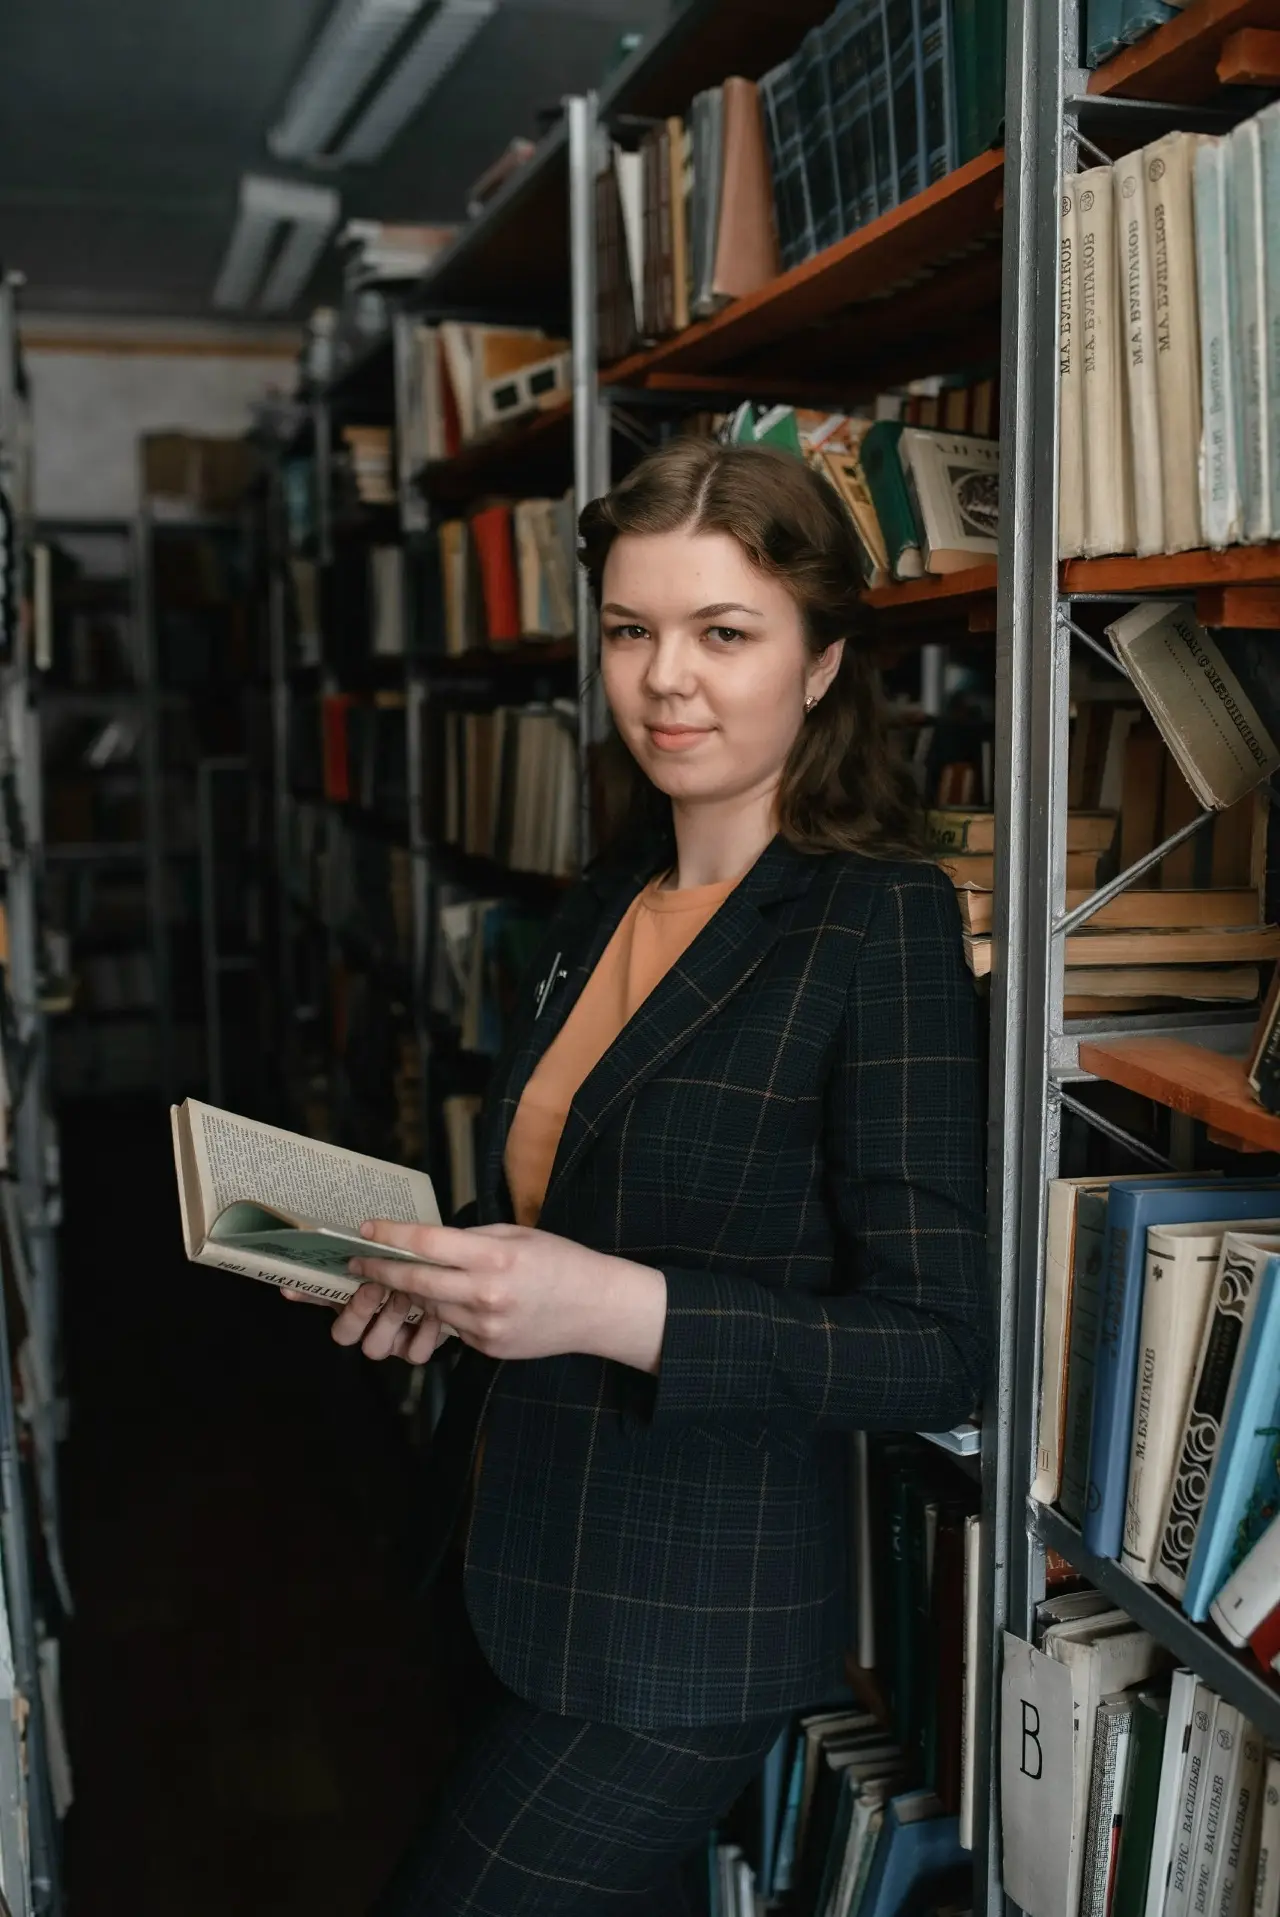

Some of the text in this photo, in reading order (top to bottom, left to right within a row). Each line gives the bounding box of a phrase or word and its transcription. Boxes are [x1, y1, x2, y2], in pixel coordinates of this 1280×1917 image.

[1060, 237, 1072, 335] БУЛГАКОВ
[1083, 232, 1095, 331] БУЛГАКОВ
[1128, 219, 1141, 323] БУЛГАКОВ
[256, 1270, 353, 1301] ЛИТЕРАТУРА
[1137, 1347, 1155, 1440] БУЛГАКОВ
[1174, 1756, 1201, 1893] БОРИС ВАСИЛЬЕВ
[1194, 1775, 1224, 1914] БОРИС ВАСИЛЬЕВ
[1219, 1788, 1250, 1917] ОРИС ВАСИЛЬЕВ
